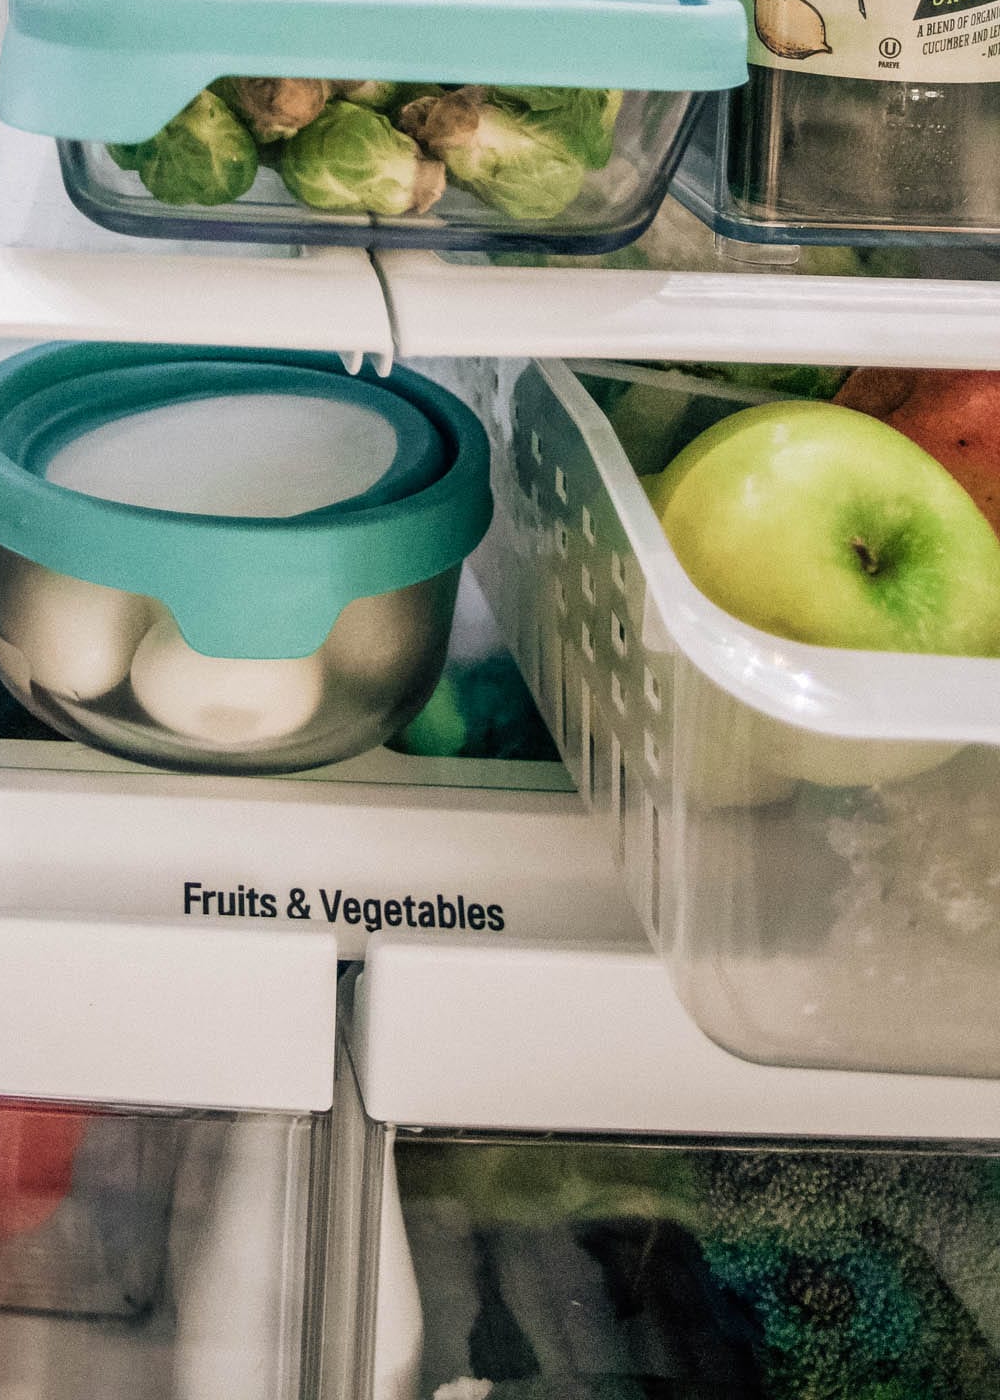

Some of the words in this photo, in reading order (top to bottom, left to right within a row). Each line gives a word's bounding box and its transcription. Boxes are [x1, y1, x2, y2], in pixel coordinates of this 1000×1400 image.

[917, 24, 923, 38] A
[927, 18, 955, 36] BLEND
[957, 15, 969, 30] OF
[970, 6, 1000, 27] ORGANI
[922, 33, 970, 56] CUCUMBER
[971, 28, 988, 45] AND
[878, 61, 901, 69] PAREVE
[183, 882, 278, 919] Fruits
[286, 887, 312, 920] &
[318, 888, 506, 933] Vegetables
